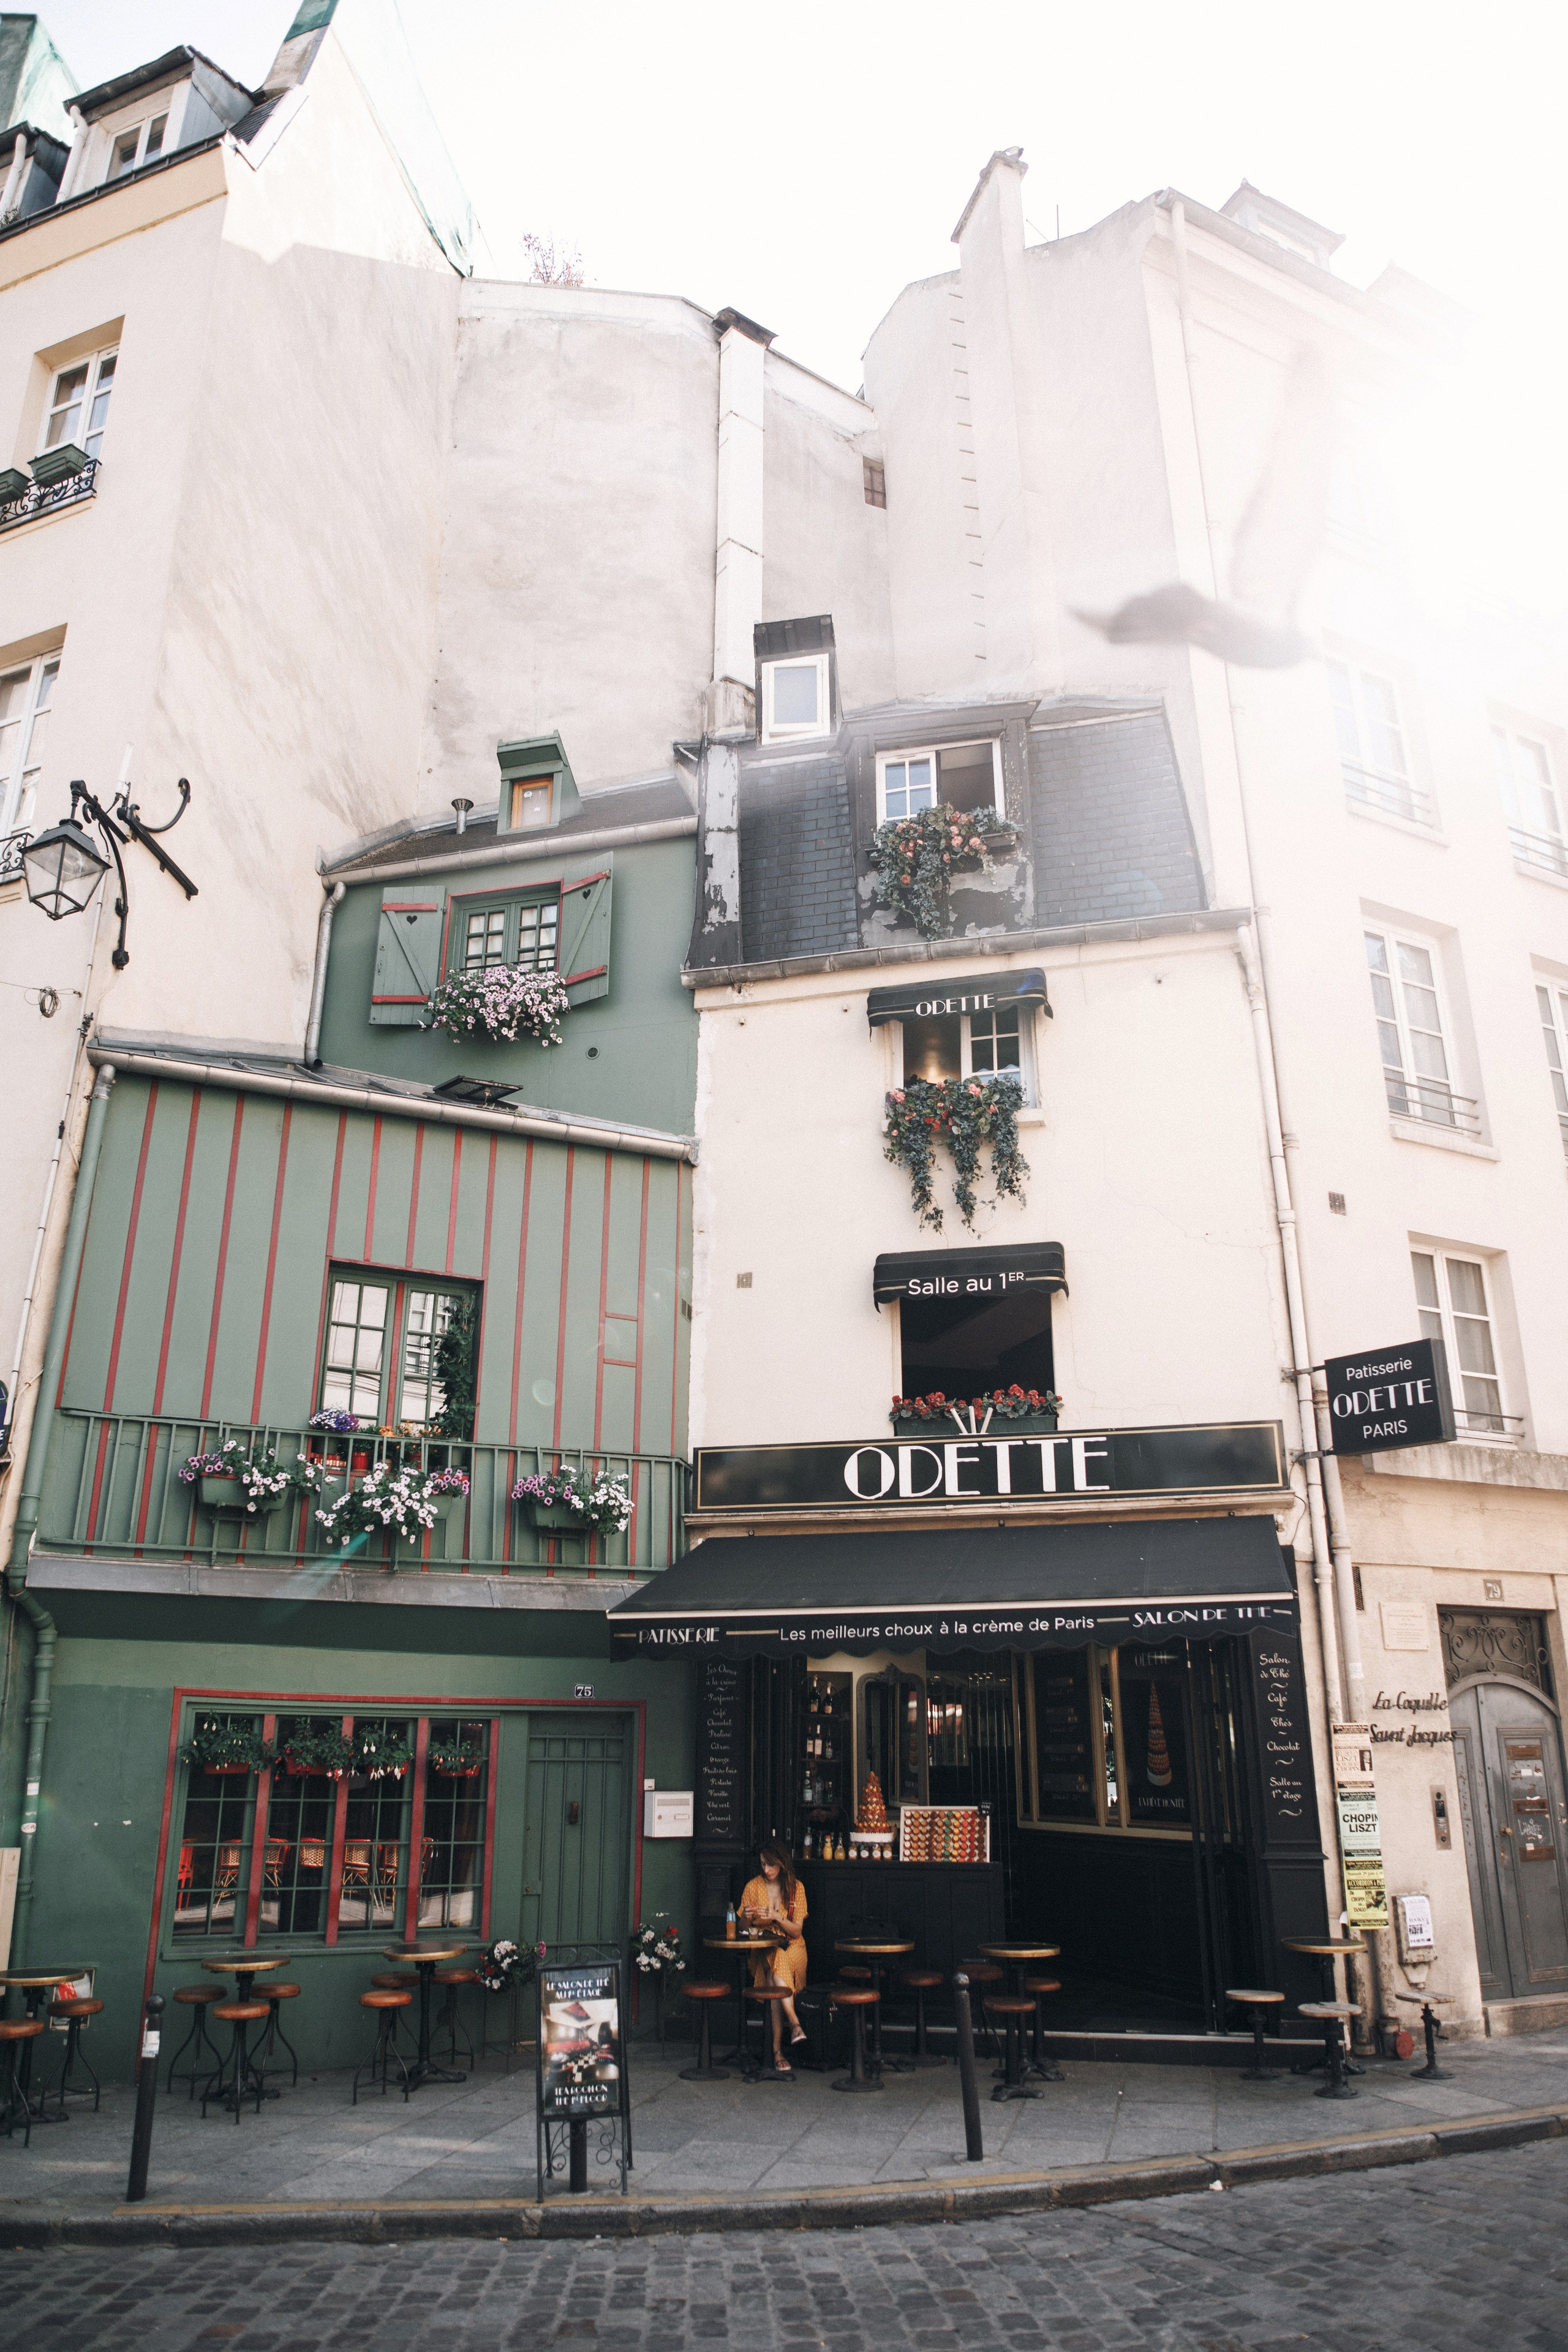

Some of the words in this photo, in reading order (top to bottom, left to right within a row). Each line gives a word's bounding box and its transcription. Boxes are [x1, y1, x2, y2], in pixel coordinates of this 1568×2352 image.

[916, 993, 995, 1016] ODETTE
[908, 1277, 959, 1295] Salle
[966, 1278, 992, 1292] au
[1346, 1358, 1412, 1381] Patisserie
[1333, 1378, 1433, 1417] ODETTE
[1363, 1420, 1408, 1439] PARIS
[844, 1437, 1110, 1500] ODETTE
[1486, 1583, 1501, 1598] 79
[639, 1627, 720, 1645] PATISSERIE
[780, 1628, 806, 1641] Les
[811, 1625, 880, 1640] meilleurs
[885, 1623, 932, 1636] choux
[940, 1621, 949, 1635] à
[954, 1621, 967, 1634] la
[973, 1619, 1023, 1633] crème
[1028, 1618, 1049, 1631] de
[1055, 1616, 1095, 1630] Paris
[1133, 1610, 1199, 1628] SALON
[1202, 1609, 1227, 1621] DE
[1260, 1653, 1290, 1666] Salon
[712, 1676, 718, 1685] la
[576, 1686, 592, 1697] 75
[1268, 1692, 1287, 1707] Café
[1373, 1691, 1392, 1710] La
[1392, 1691, 1449, 1714] Coquille
[1370, 1724, 1405, 1743] Saint
[1406, 1724, 1457, 1747] Jacques
[1267, 1741, 1300, 1751] Chocolat
[1270, 1777, 1291, 1787] Salle
[1343, 1814, 1378, 1823] CHOPIN
[1349, 1823, 1377, 1833] LISZT
